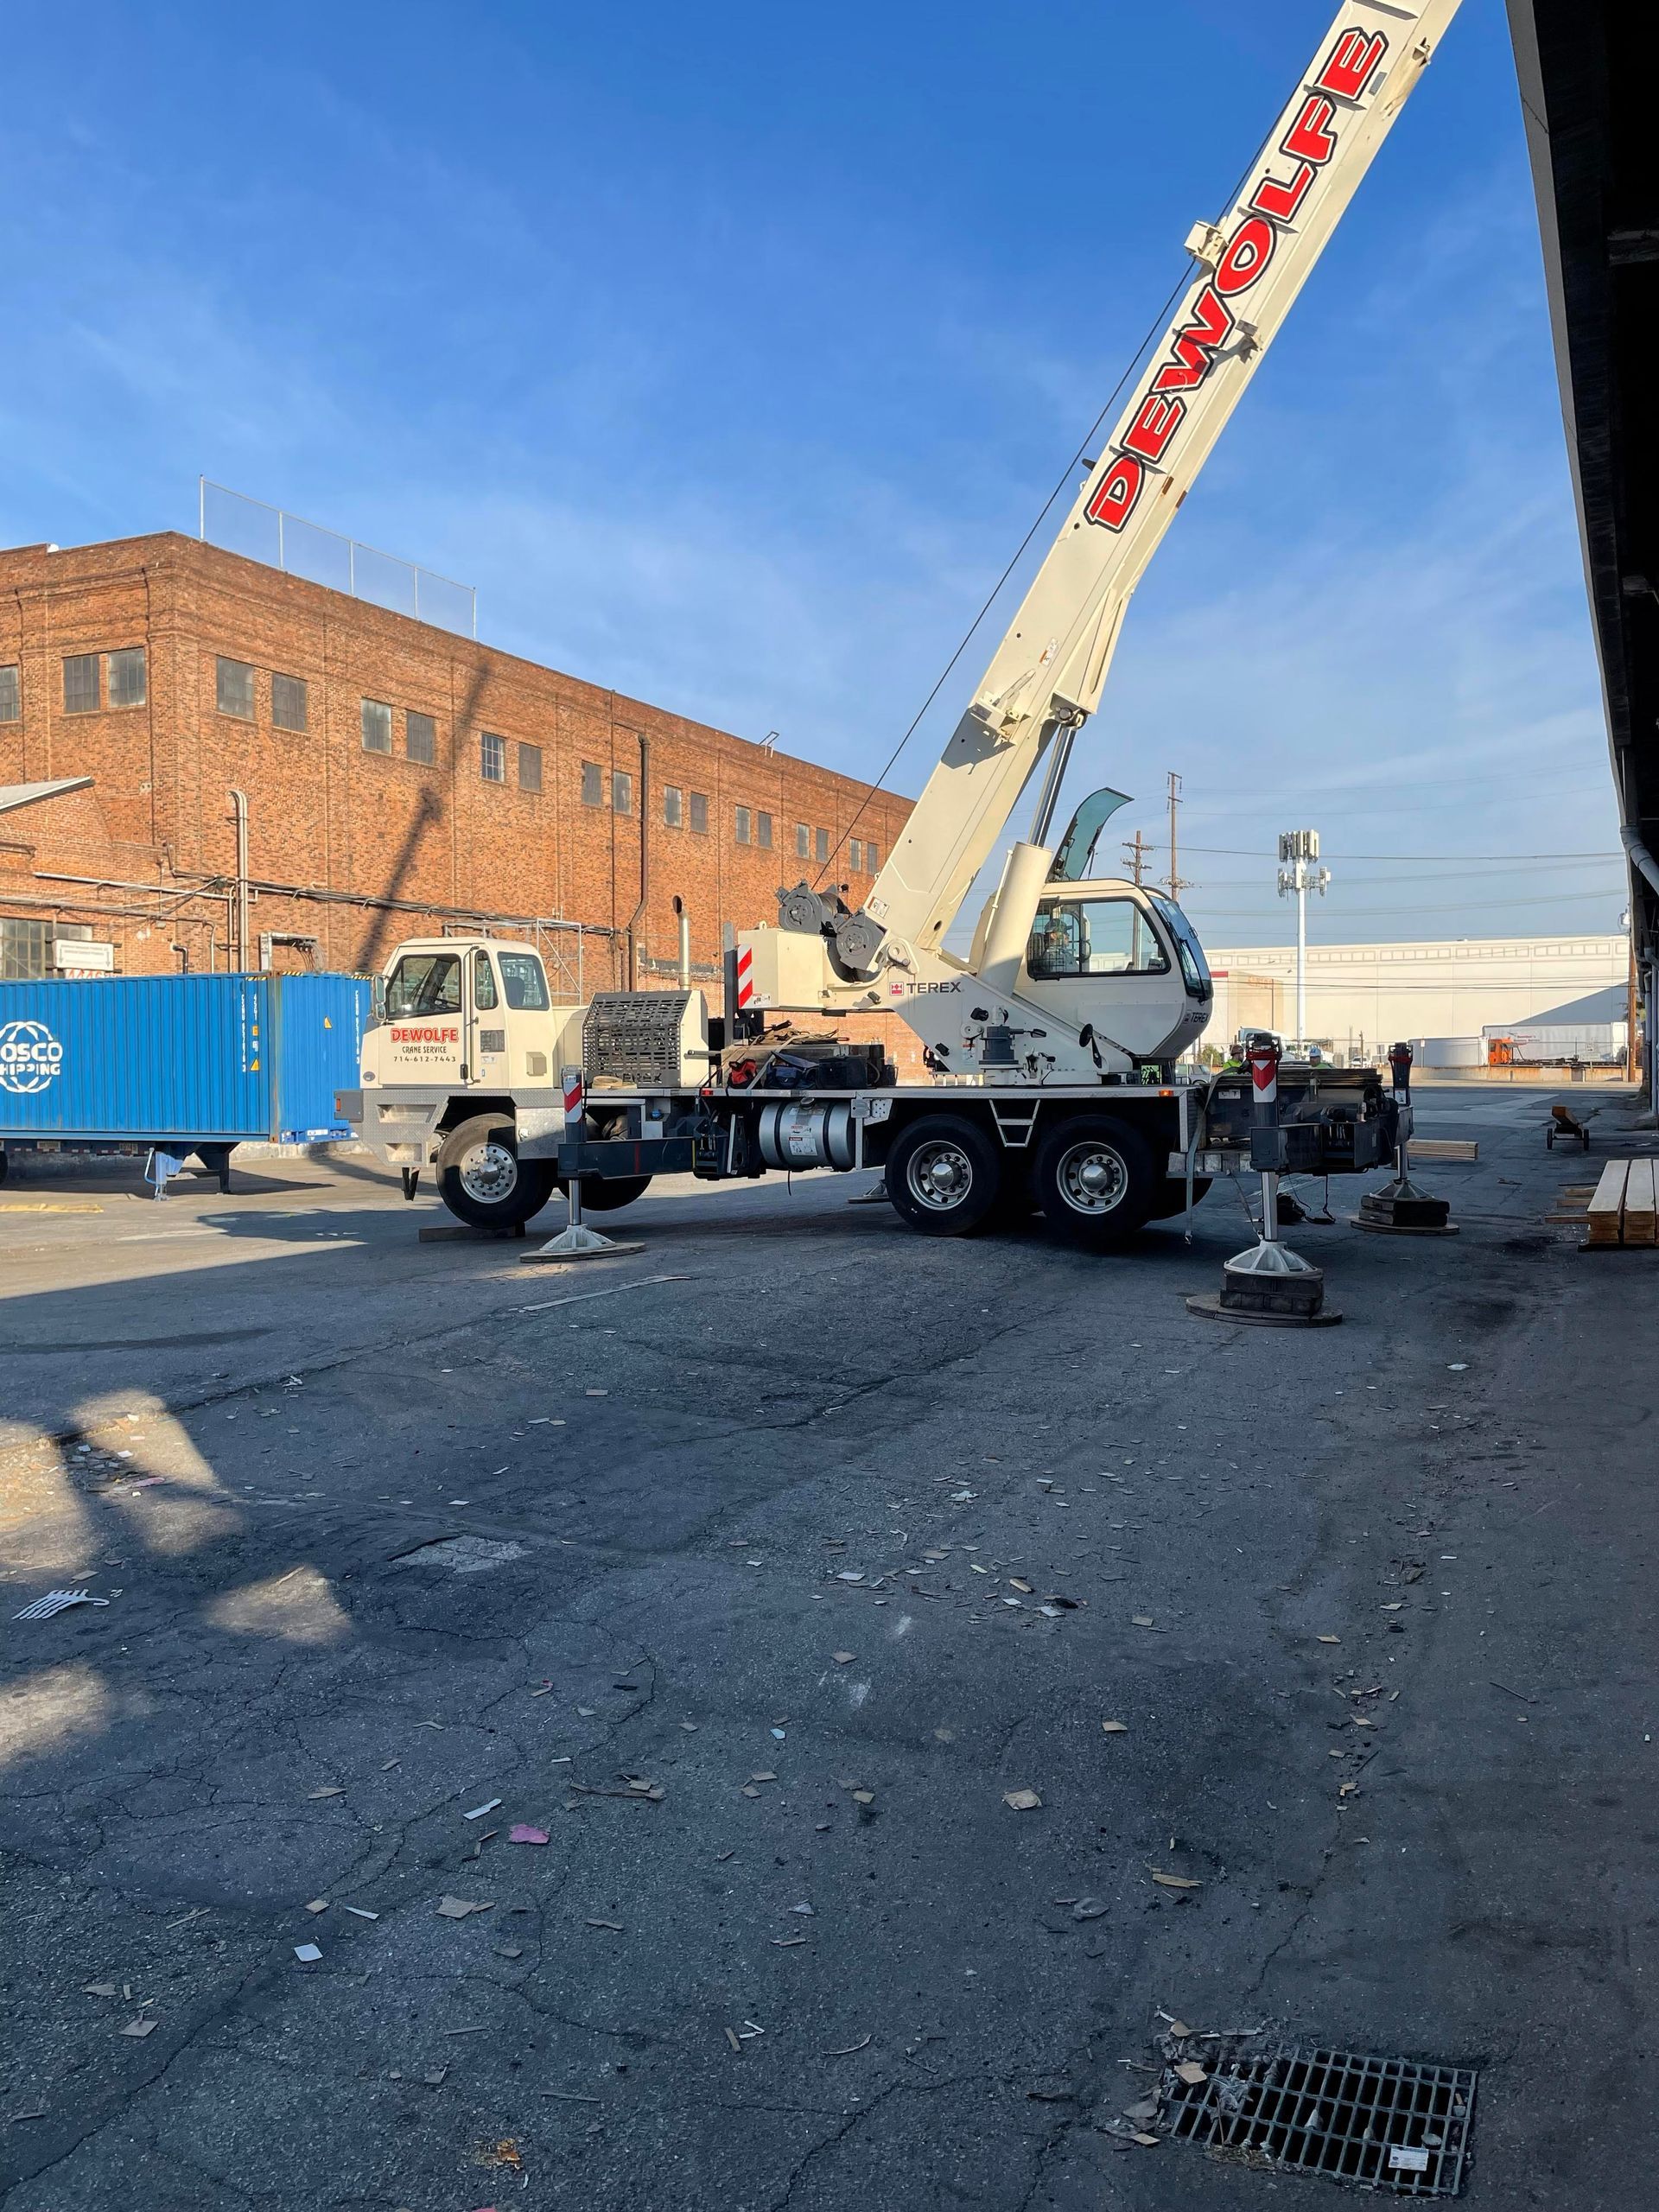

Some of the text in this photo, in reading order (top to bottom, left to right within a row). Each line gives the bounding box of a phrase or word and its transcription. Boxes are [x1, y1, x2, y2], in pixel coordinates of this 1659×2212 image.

[1084, 26, 1389, 533] DEWOLFE
[906, 982, 962, 994] TEREX
[391, 1027, 460, 1044] DEWOLFE
[0, 1041, 63, 1063] OSCO
[402, 1046, 448, 1054] CRANE SERVICE
[0, 1063, 60, 1076] HIPPING
